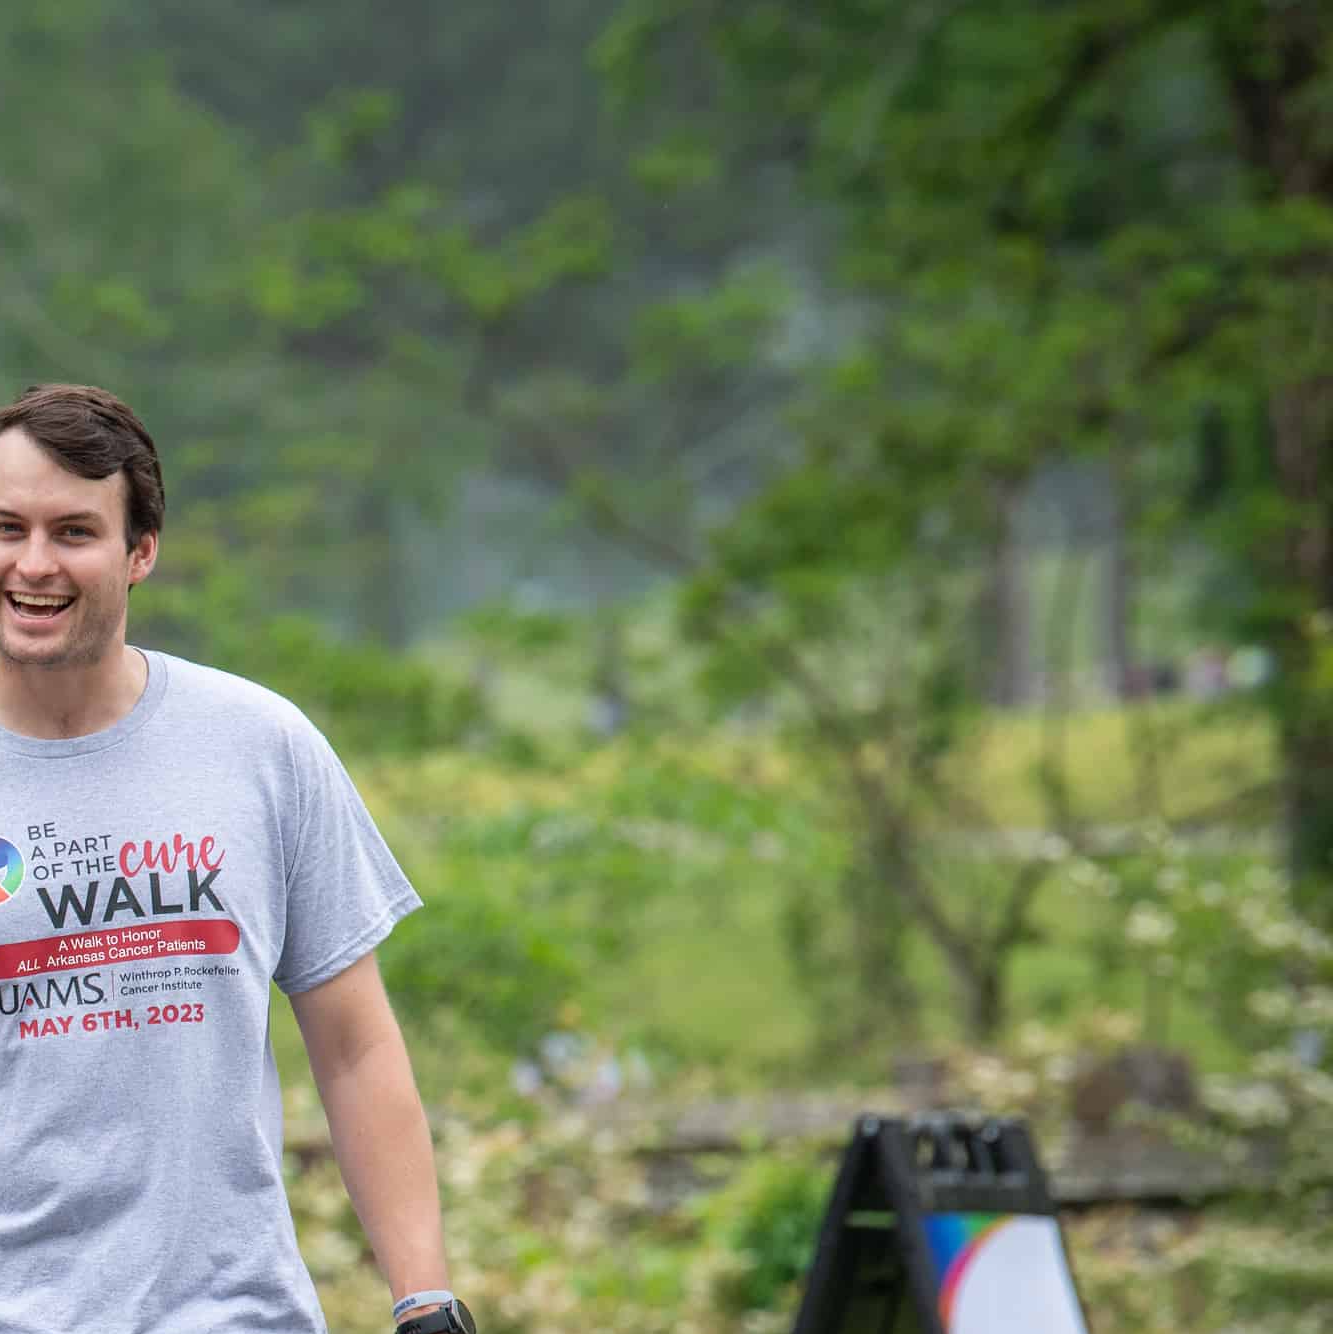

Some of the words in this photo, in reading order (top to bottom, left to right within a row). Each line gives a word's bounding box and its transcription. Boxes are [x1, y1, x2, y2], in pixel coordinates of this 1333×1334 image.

[27, 822, 57, 840] BE
[31, 846, 46, 860] A
[54, 834, 112, 856] PART
[33, 863, 63, 880] OF
[71, 855, 116, 876] THE
[119, 833, 226, 878] cure
[36, 868, 225, 929] WALK
[59, 940, 69, 952] A
[71, 934, 103, 950] Walk
[106, 934, 119, 945] to
[122, 929, 162, 943] Honor
[17, 959, 41, 973] ALL
[46, 951, 106, 967] Arkansas
[108, 942, 155, 960] Cancer
[157, 939, 206, 953] Patients
[119, 968, 172, 982] Winthrop
[174, 967, 182, 976] P.
[184, 965, 240, 976] Rockefeller
[120, 984, 159, 996] Cancer
[161, 981, 203, 991] Institute
[20, 1016, 74, 1040] MAY
[82, 1010, 140, 1032] 6TH,
[147, 1003, 204, 1025] 2023
